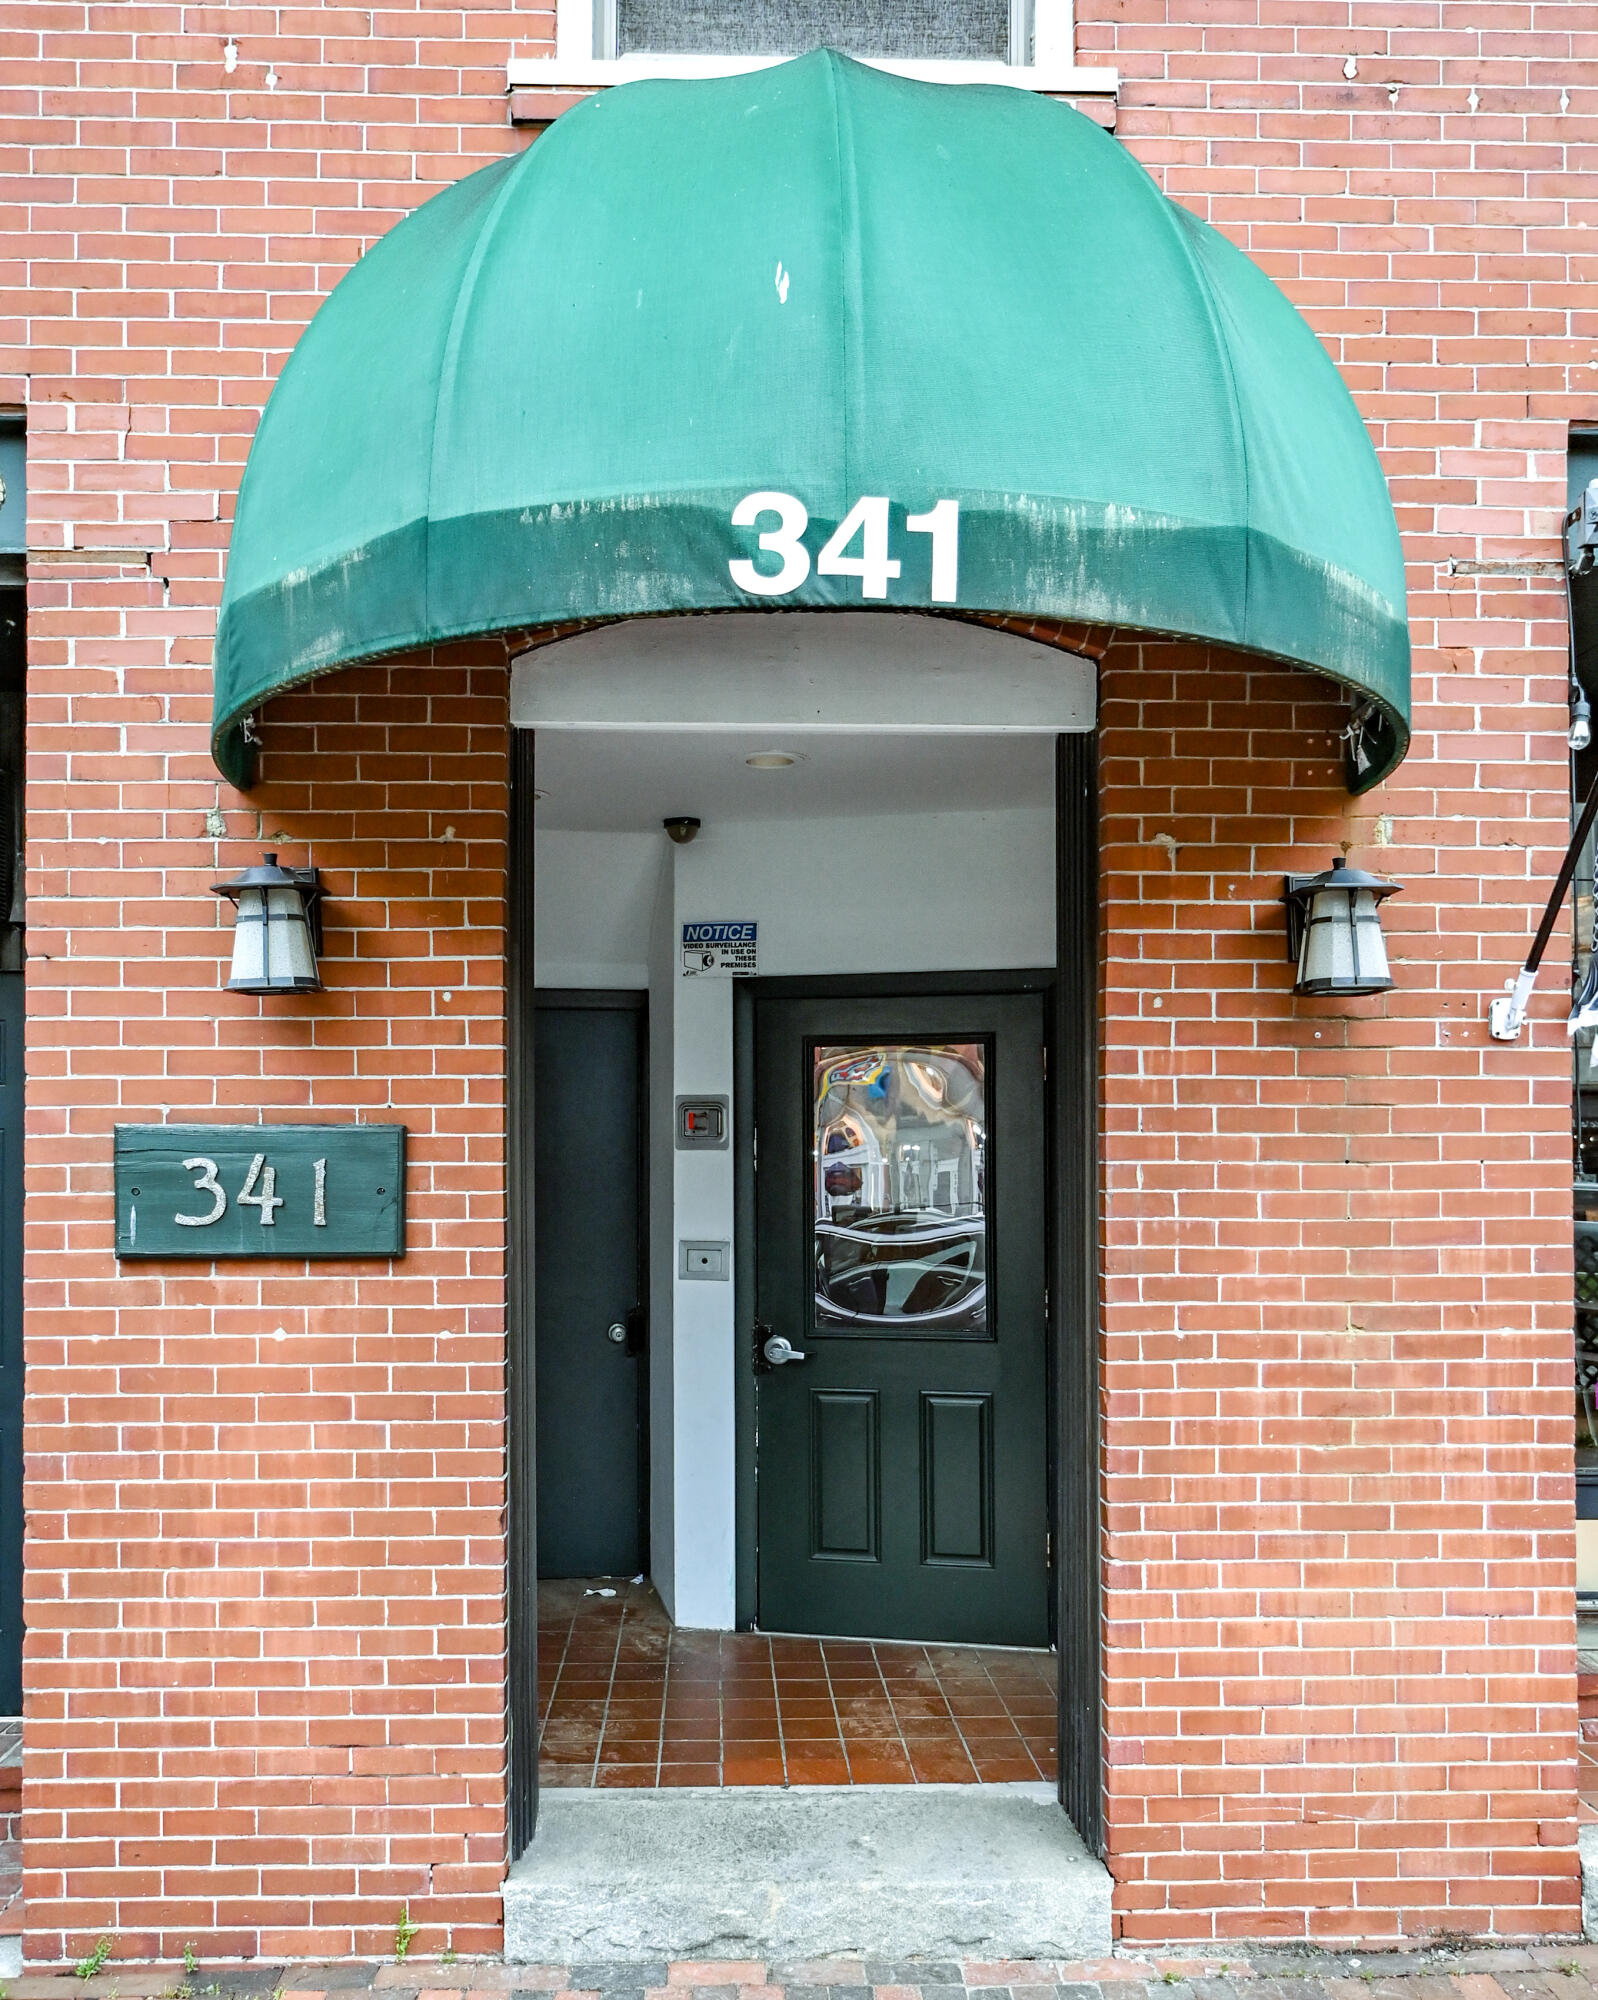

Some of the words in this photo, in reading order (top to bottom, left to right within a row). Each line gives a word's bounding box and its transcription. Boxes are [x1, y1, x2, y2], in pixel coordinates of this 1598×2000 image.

[728, 491, 959, 603] 341
[686, 925, 753, 940] NOTICE
[174, 1153, 327, 1226] 341
